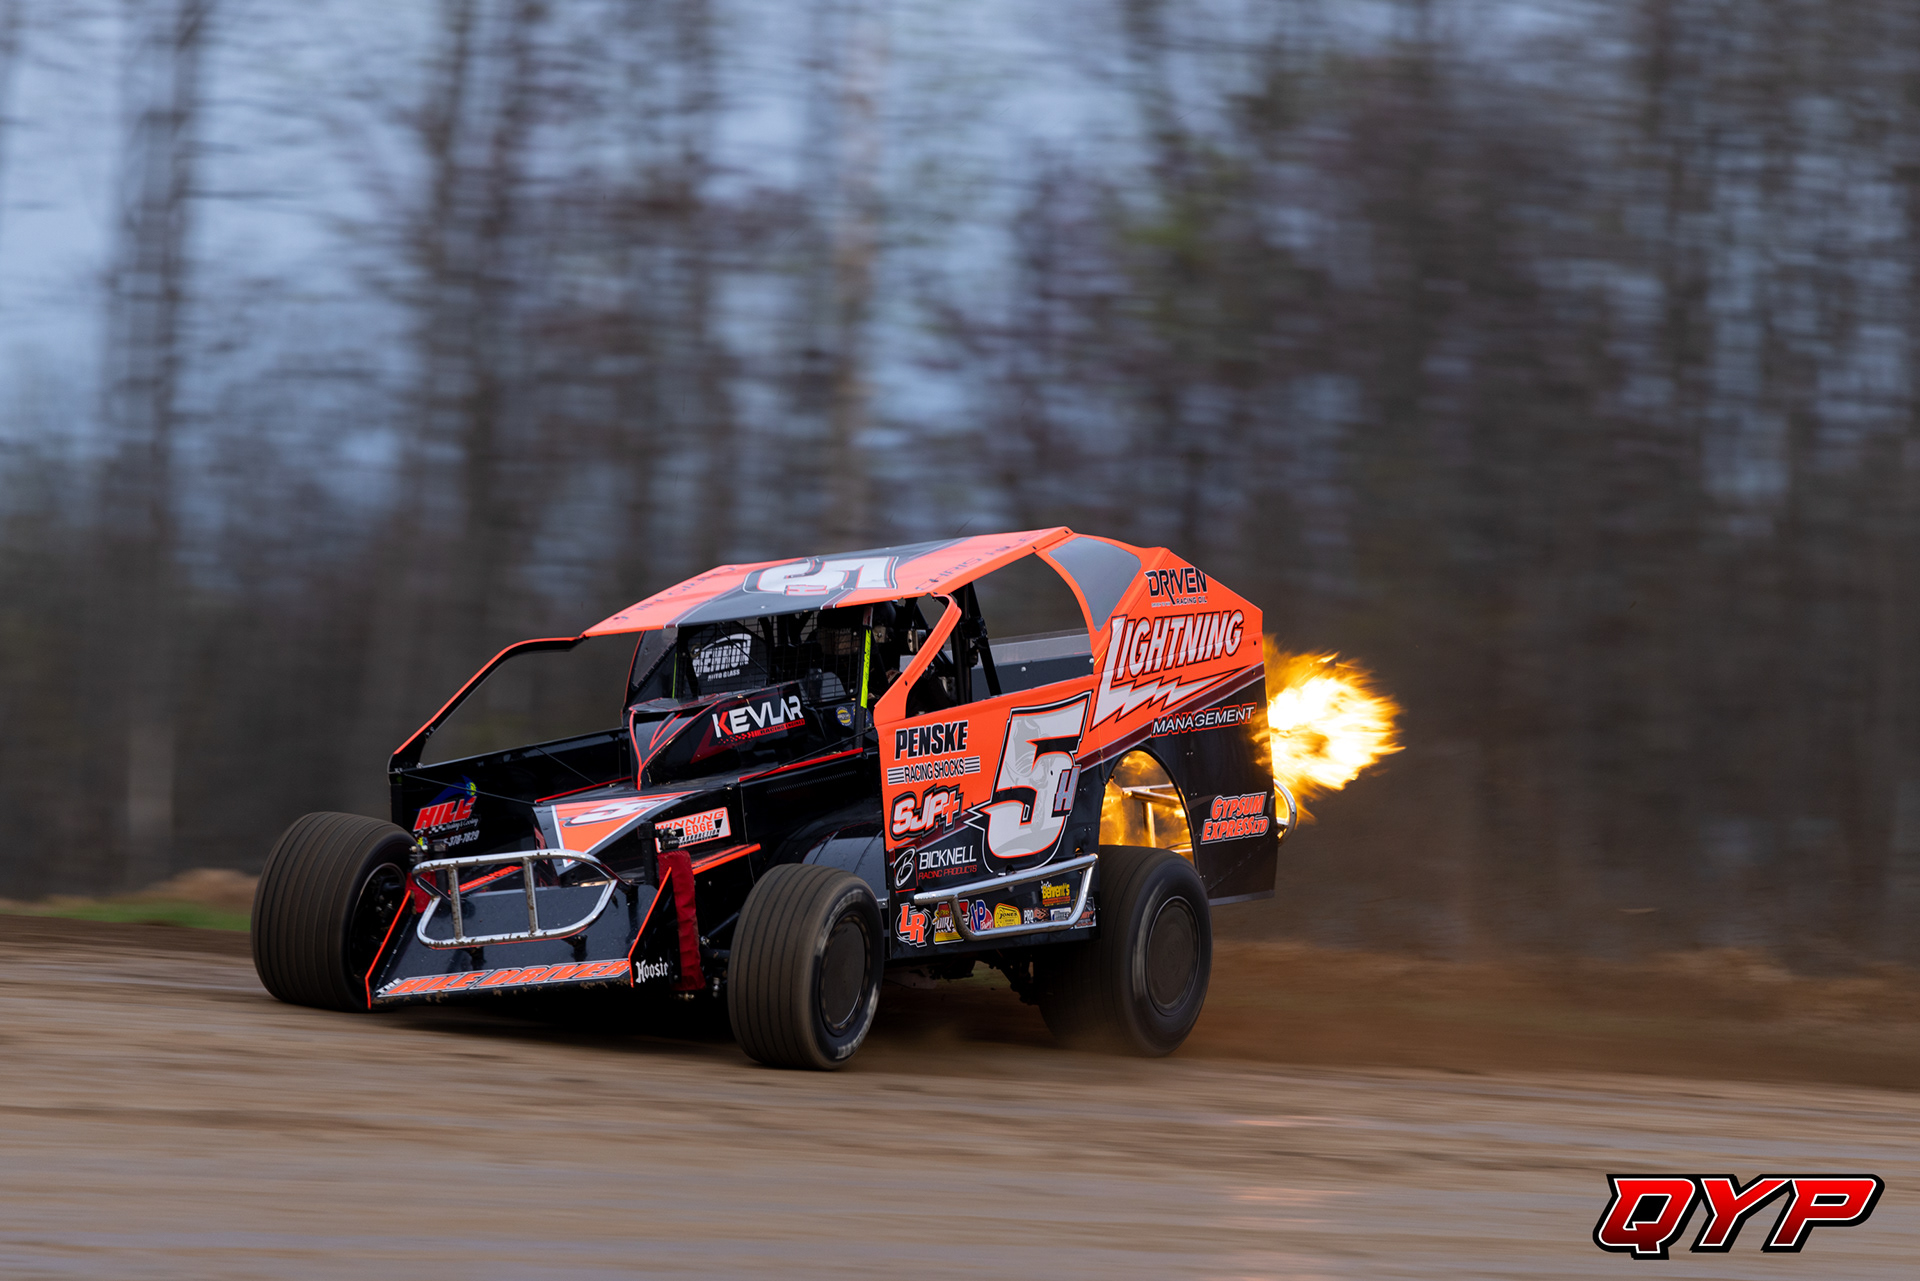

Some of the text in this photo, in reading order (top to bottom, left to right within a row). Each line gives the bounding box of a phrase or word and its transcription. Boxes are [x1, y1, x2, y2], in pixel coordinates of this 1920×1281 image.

[1145, 567, 1208, 604] DRIVEN
[1176, 597, 1197, 605] RACING
[1198, 596, 1208, 604] OIL
[722, 668, 741, 679] GLASS
[1091, 609, 1246, 729] LIGHTNING
[712, 695, 804, 738] KEVLAR
[1152, 706, 1255, 735] MANAGEMENT
[894, 720, 969, 761] PENSKE
[904, 760, 965, 785] RACING SHOCKS
[413, 796, 477, 832] HILE
[1211, 795, 1265, 820] GYPSUM
[656, 810, 725, 831] WINNING
[684, 820, 714, 837] EDGE
[919, 845, 977, 870] BICKNELL
[918, 864, 977, 881] RACING PRODUCTS
[1042, 883, 1071, 900] Behrent's
[999, 912, 1018, 920] JONES
[1024, 909, 1034, 922] PRO
[386, 970, 486, 995] HILE
[478, 959, 630, 988] DRIVER
[635, 956, 673, 984] Hoosie
